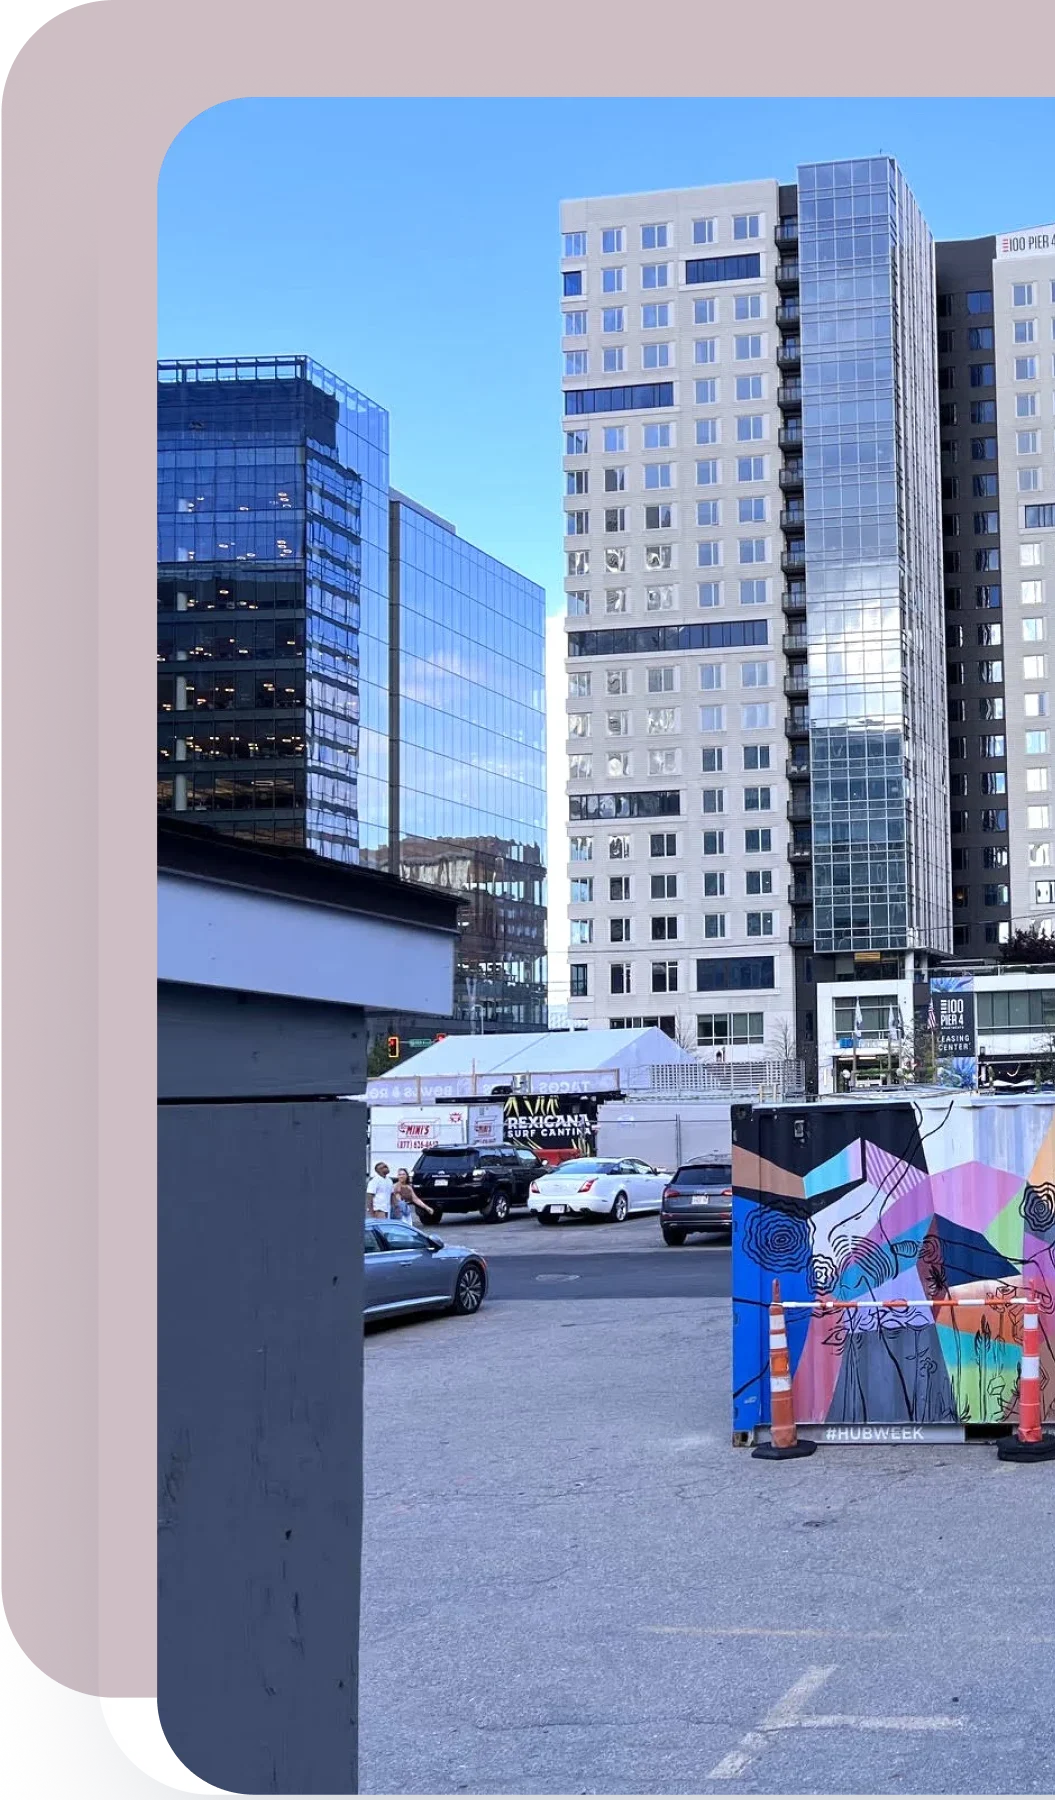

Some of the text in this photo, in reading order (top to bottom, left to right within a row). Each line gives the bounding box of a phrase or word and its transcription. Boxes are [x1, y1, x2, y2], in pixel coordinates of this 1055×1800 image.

[1028, 234, 1049, 250] PIER
[940, 1014, 964, 1026] PIER 4
[938, 1042, 969, 1051] CENTER
[506, 1114, 591, 1129] REXICANA
[507, 1128, 591, 1138] SURF CANTINA
[825, 1427, 924, 1441] #HUBWEEK
